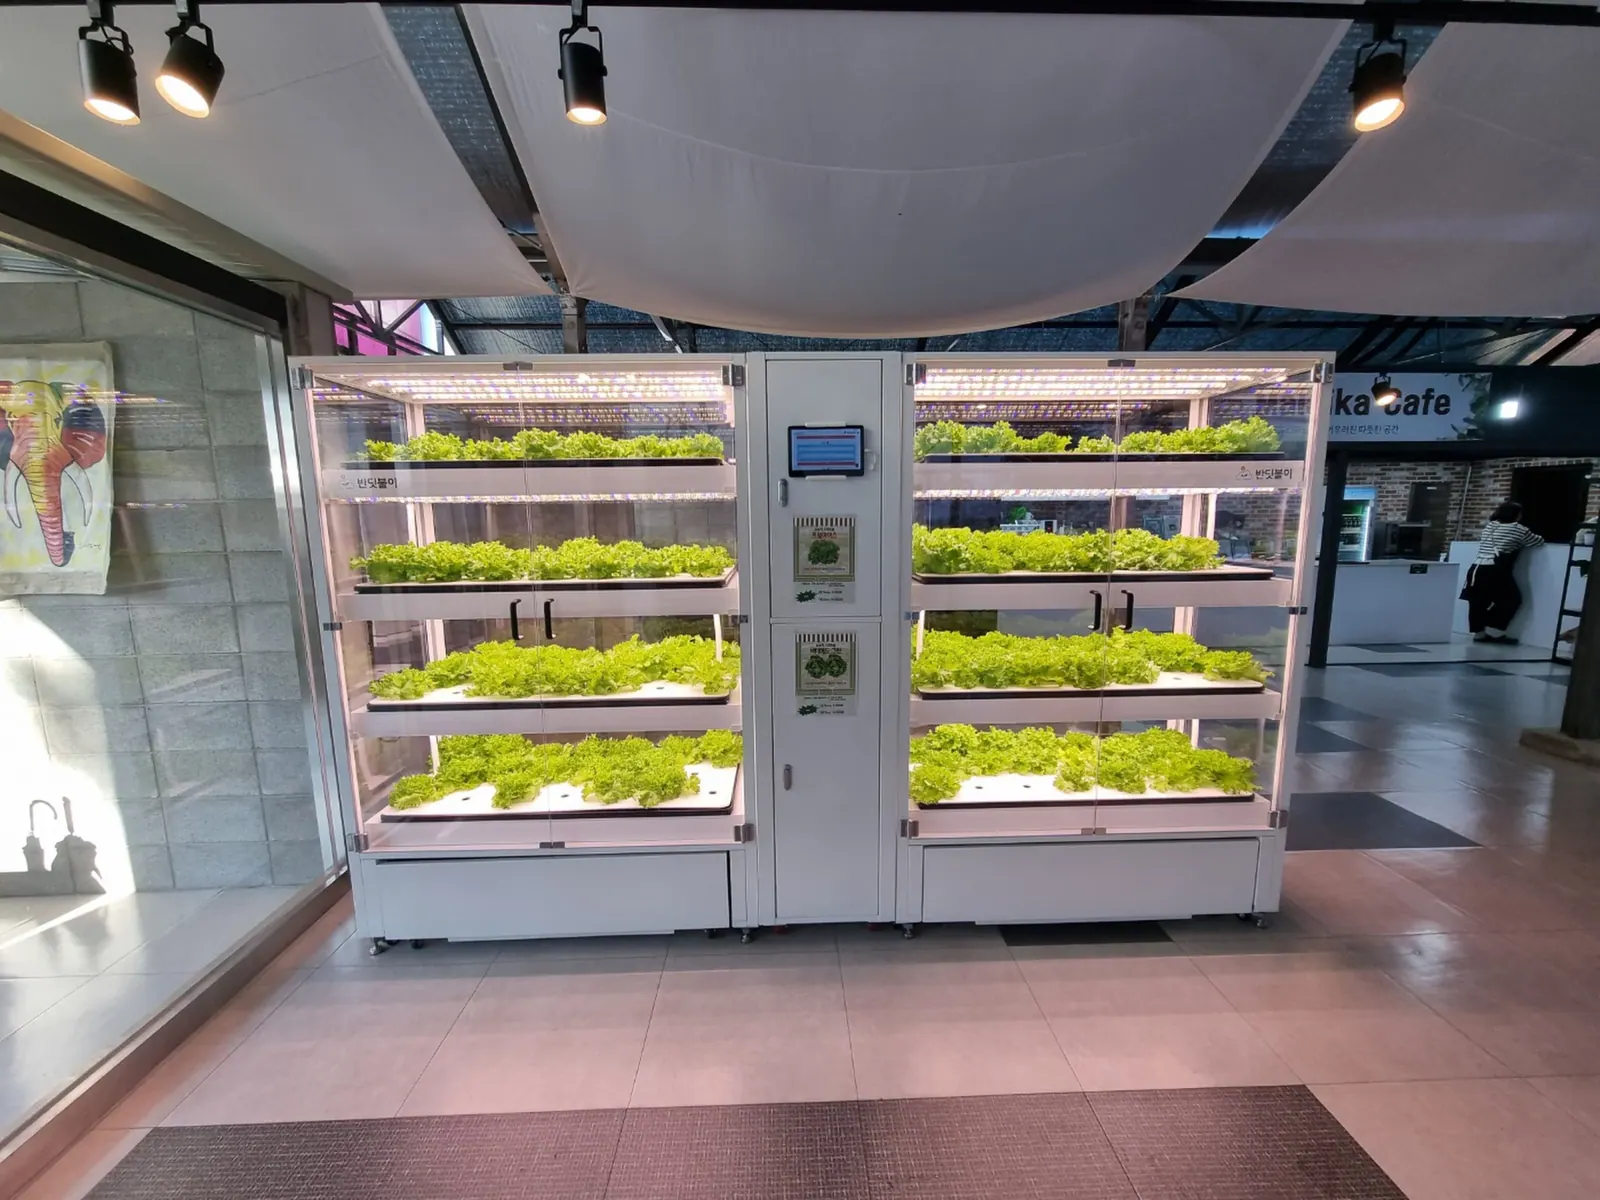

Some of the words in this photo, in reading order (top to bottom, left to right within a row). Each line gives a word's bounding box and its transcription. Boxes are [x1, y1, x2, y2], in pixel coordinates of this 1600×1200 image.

[1384, 424, 1399, 435] 공간
[1255, 468, 1293, 480] 반딧불이
[357, 477, 398, 489] 반딧불이
